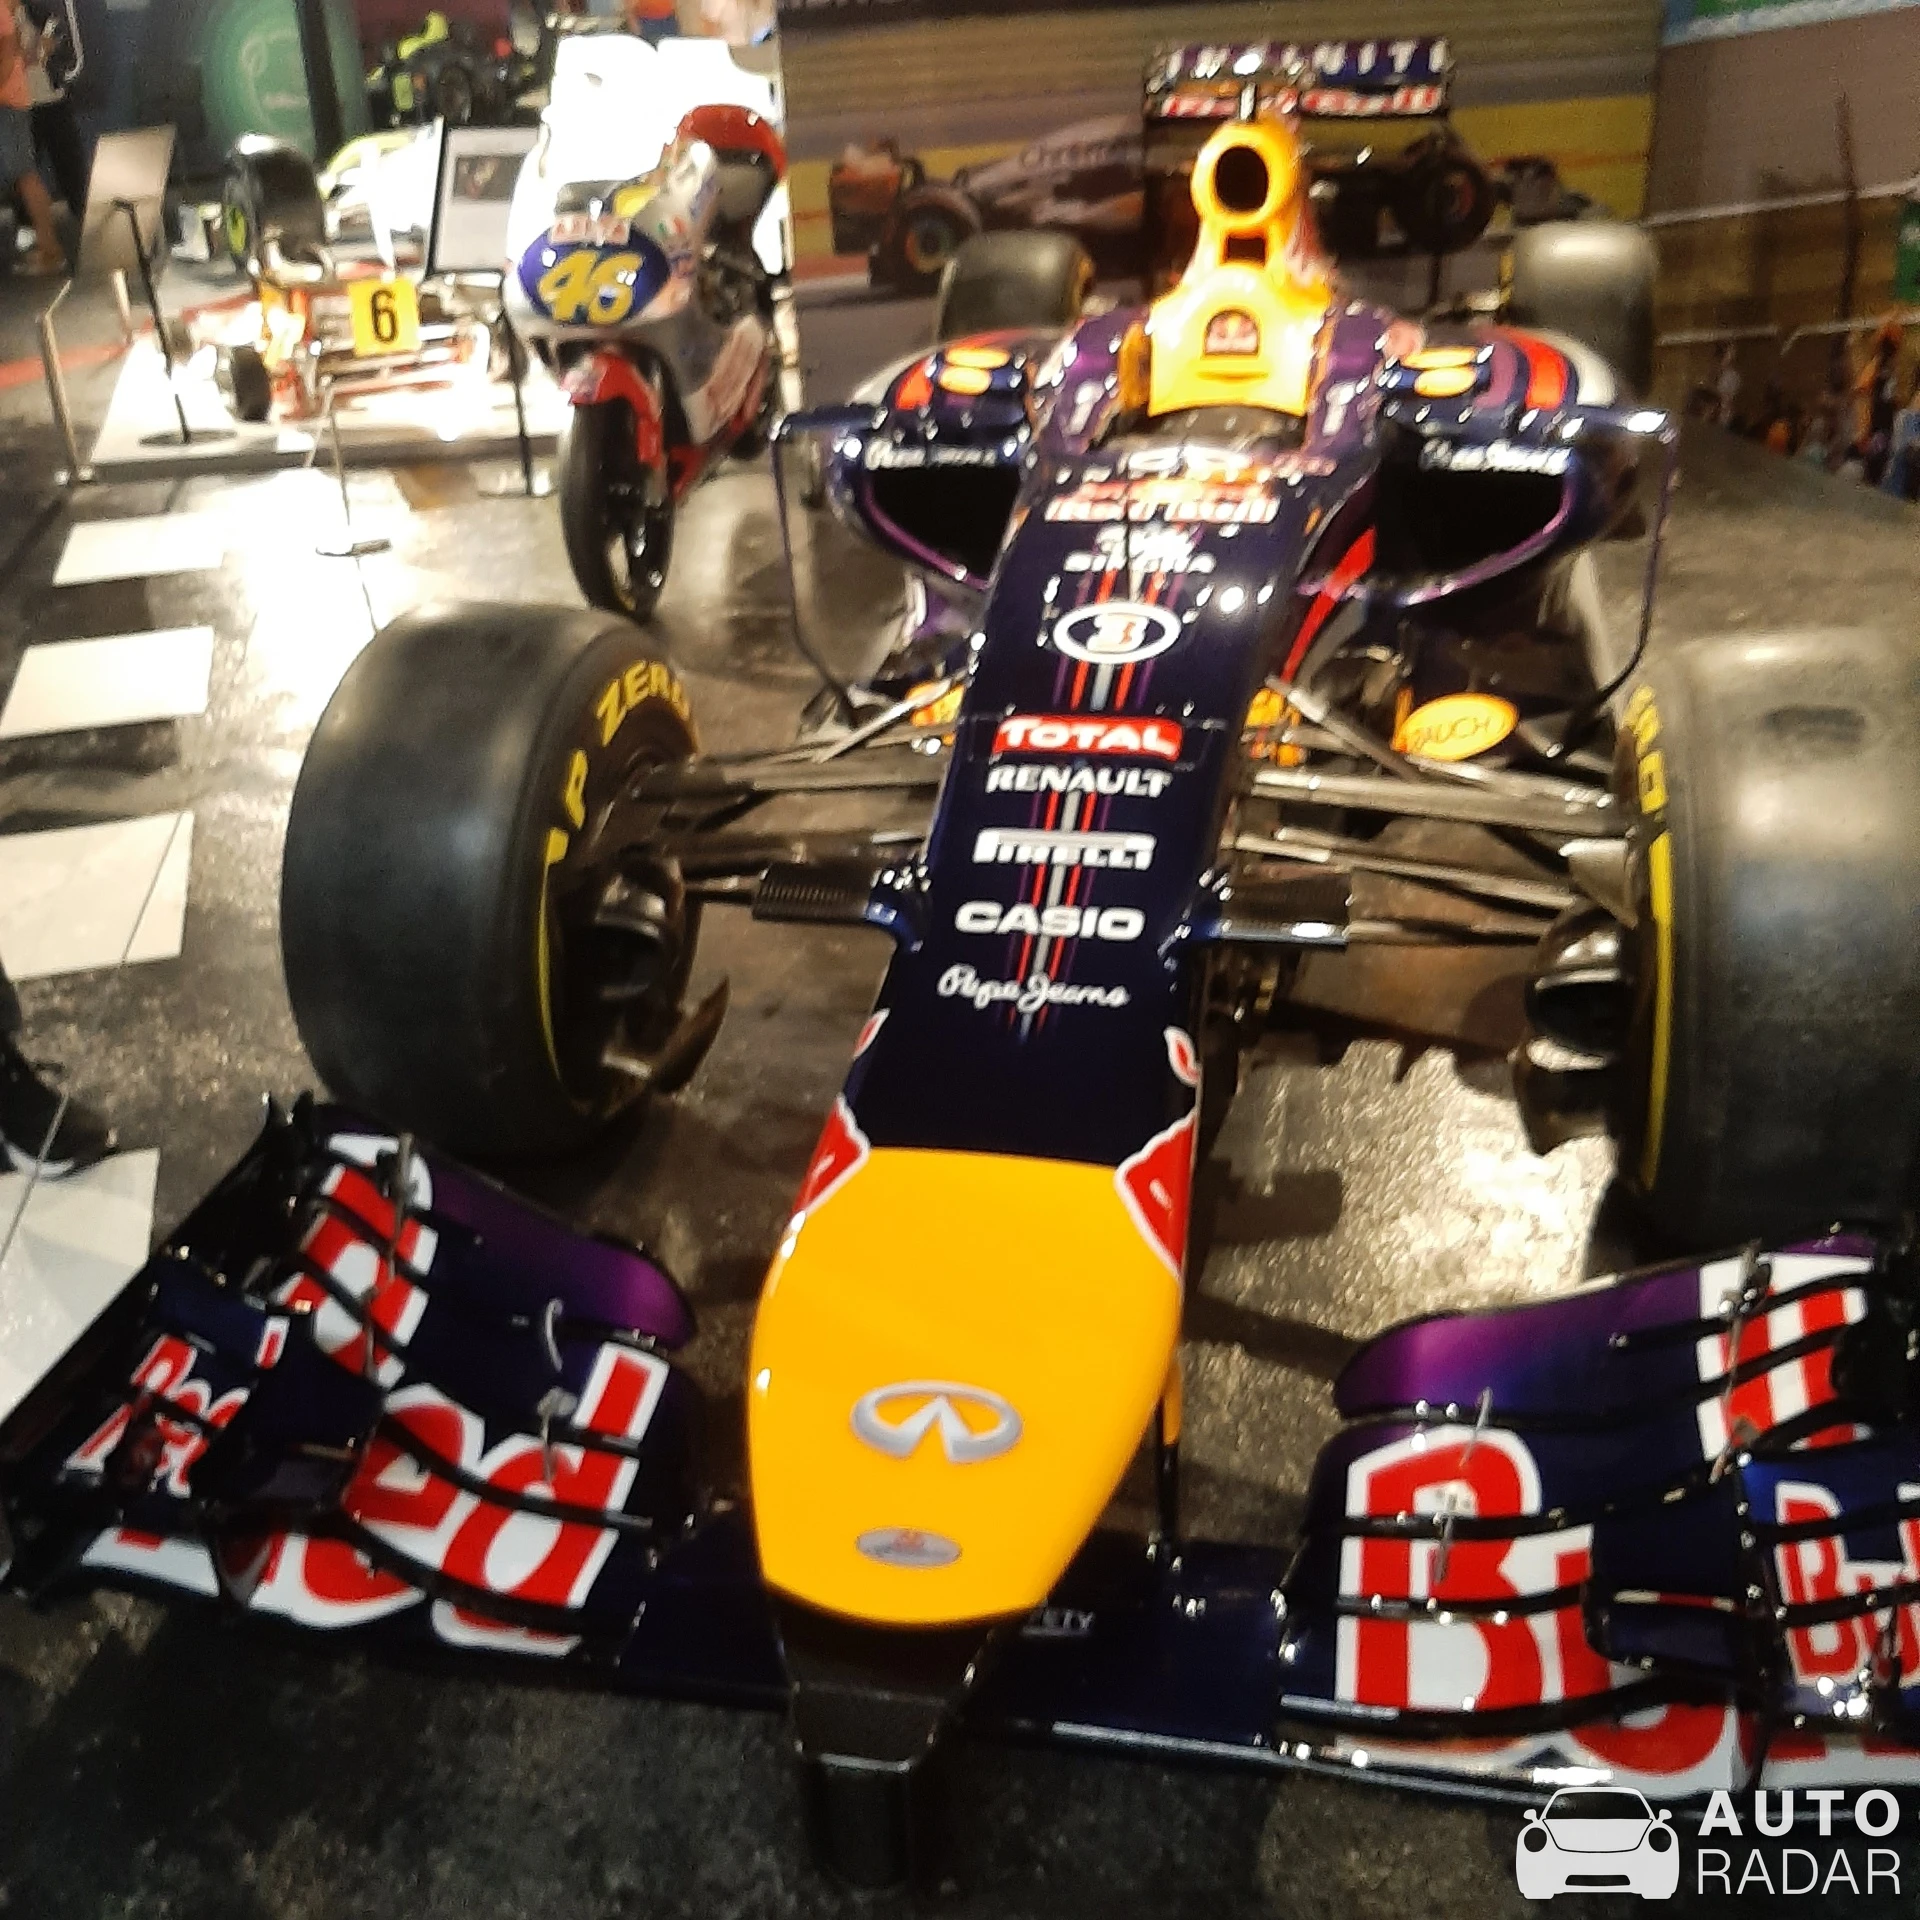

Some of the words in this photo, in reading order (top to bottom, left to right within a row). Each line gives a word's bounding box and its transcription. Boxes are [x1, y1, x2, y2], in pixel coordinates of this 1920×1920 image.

[537, 250, 645, 325] 46
[371, 289, 400, 344] 6
[1000, 717, 1176, 756] TOTAL
[986, 764, 1173, 799] RENAULT
[972, 827, 1158, 871] PIRELLI
[955, 901, 1146, 941] CASIO
